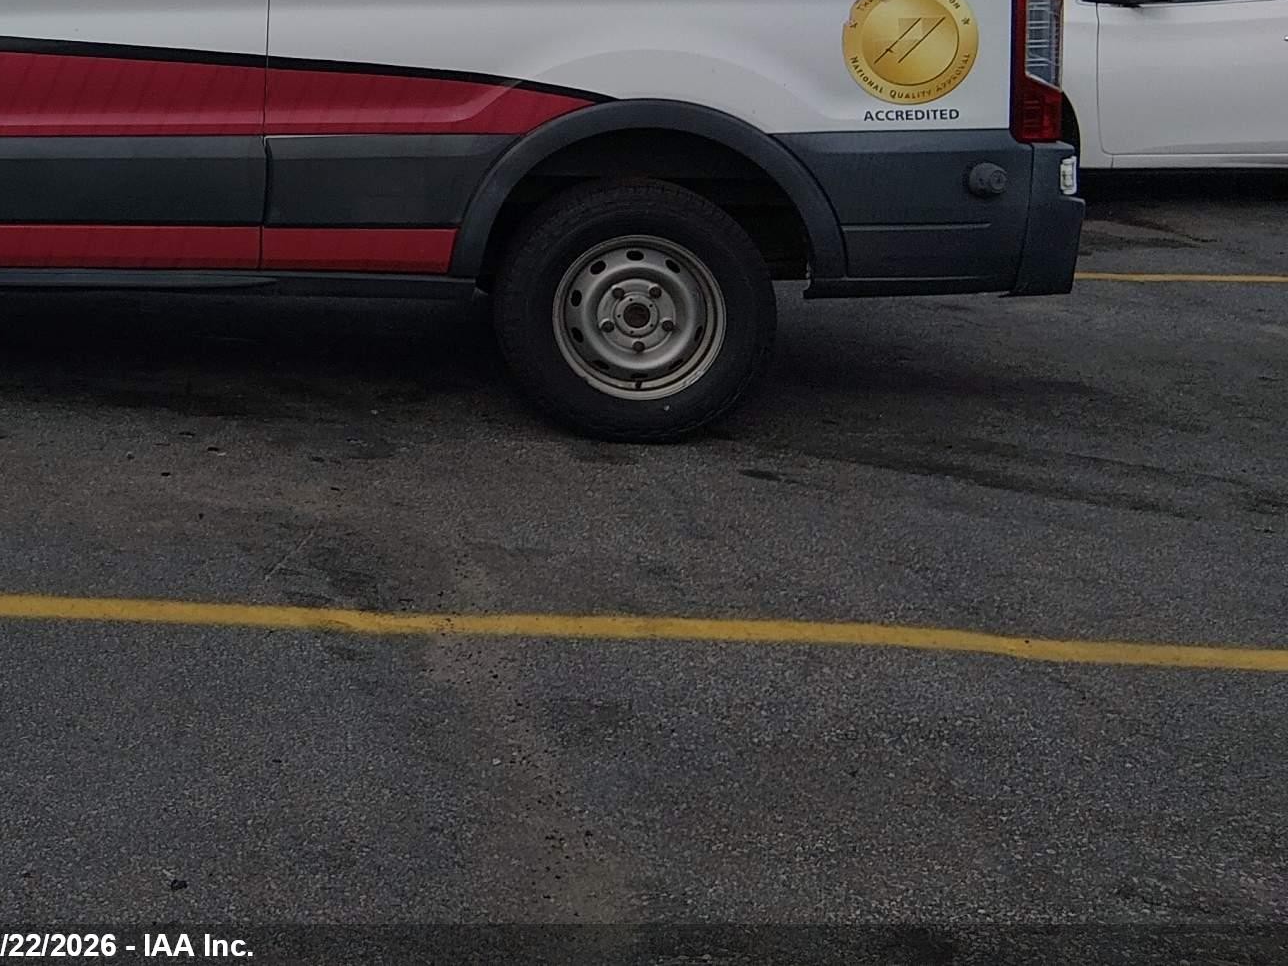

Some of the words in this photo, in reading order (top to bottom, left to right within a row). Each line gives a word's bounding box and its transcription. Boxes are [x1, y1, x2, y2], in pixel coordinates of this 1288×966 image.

[850, 55, 884, 95] NATIONAL
[889, 88, 932, 100] QUALITY
[864, 108, 960, 122] ACCREDITED
